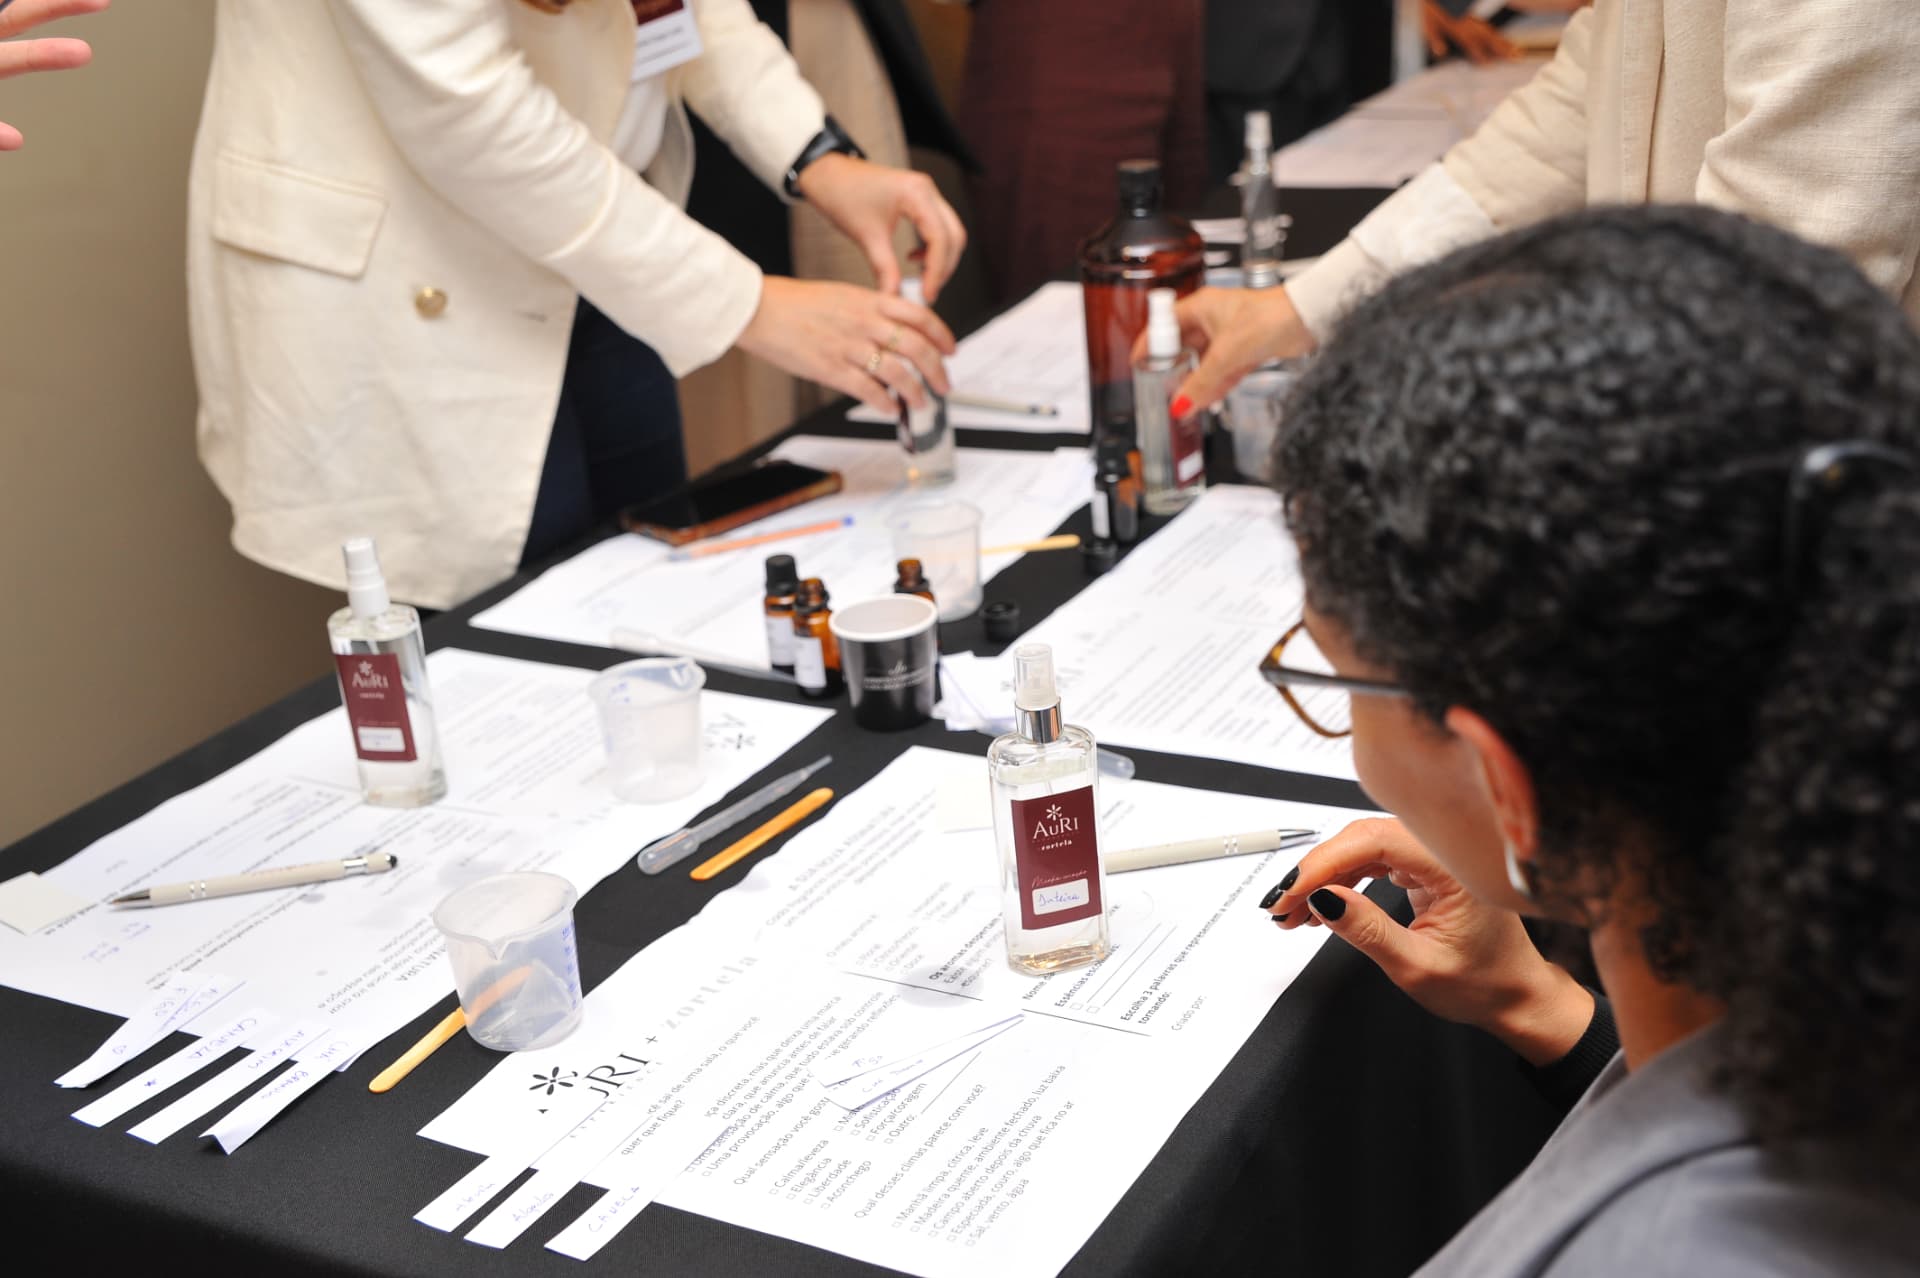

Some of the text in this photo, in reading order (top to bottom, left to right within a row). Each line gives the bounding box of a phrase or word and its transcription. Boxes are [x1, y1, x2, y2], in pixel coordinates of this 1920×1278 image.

[1022, 982, 1047, 1000] Nome
[1054, 976, 1089, 1008] Essências
[1121, 994, 1149, 1021] Escolha
[1149, 963, 1178, 991] palavras
[1174, 950, 1189, 963] que
[1184, 912, 1222, 952] representem
[1138, 991, 1173, 1025] tornando:
[1171, 1009, 1197, 1031] Criado
[671, 1084, 685, 1093] de
[682, 1068, 702, 1083] uma
[725, 1032, 743, 1045] que
[716, 1078, 752, 1106] discreta,
[766, 1048, 783, 1061] que
[749, 1104, 762, 1113] de
[760, 1081, 788, 1103] calma,
[785, 1067, 802, 1080] que
[621, 1100, 685, 1155] quer que fique?
[722, 1096, 752, 1119] clara,
[744, 1086, 761, 1098] que
[870, 1083, 927, 1134] Força/coragem
[706, 1152, 731, 1169] Uma
[729, 1110, 779, 1152] provocação,
[776, 1093, 794, 1108] algo
[733, 1167, 757, 1184] Qual
[755, 1133, 793, 1167] sensação
[791, 1116, 812, 1132] você
[854, 1084, 985, 1218] Qual desses climas parece com você?
[914, 1193, 950, 1224] Madeira
[947, 1164, 979, 1192] quente,
[974, 1127, 1010, 1162] ambiente
[1004, 1097, 1039, 1126] fechado,
[1032, 1084, 1049, 1095] luz
[774, 1140, 829, 1187] Calma/leveza
[827, 1161, 871, 1203] Aconchego
[896, 1193, 928, 1220] Manhã
[947, 1144, 975, 1168] cítrica,
[968, 1128, 989, 1143] leve
[933, 1115, 1042, 1229] Campo aberto depois da chuva
[950, 1195, 996, 1234] Especiada,
[991, 1169, 1018, 1192] couro,
[1013, 1151, 1031, 1168] algo
[1028, 1136, 1046, 1150] que
[1040, 1121, 1058, 1134] fica
[1054, 1111, 1067, 1120] no
[1006, 1179, 1029, 1198] água
